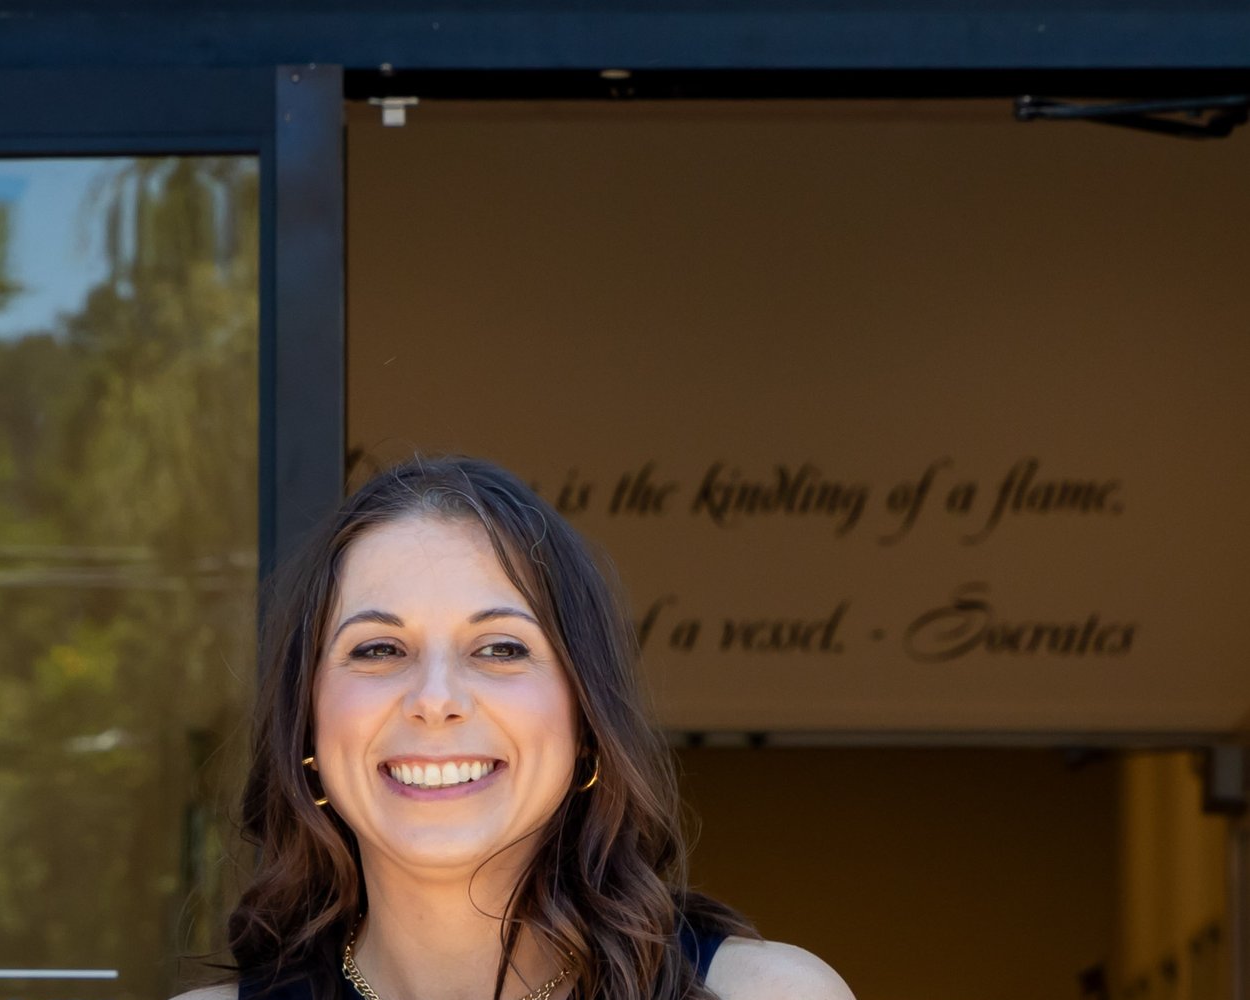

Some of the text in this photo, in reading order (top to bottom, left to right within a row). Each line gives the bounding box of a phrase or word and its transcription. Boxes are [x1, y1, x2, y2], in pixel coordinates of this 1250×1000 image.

[555, 456, 1126, 547] is the kindling of a flame.
[636, 594, 679, 652] f
[669, 618, 701, 653] a
[719, 598, 851, 654] vessel.
[902, 580, 1138, 664] Socrates
